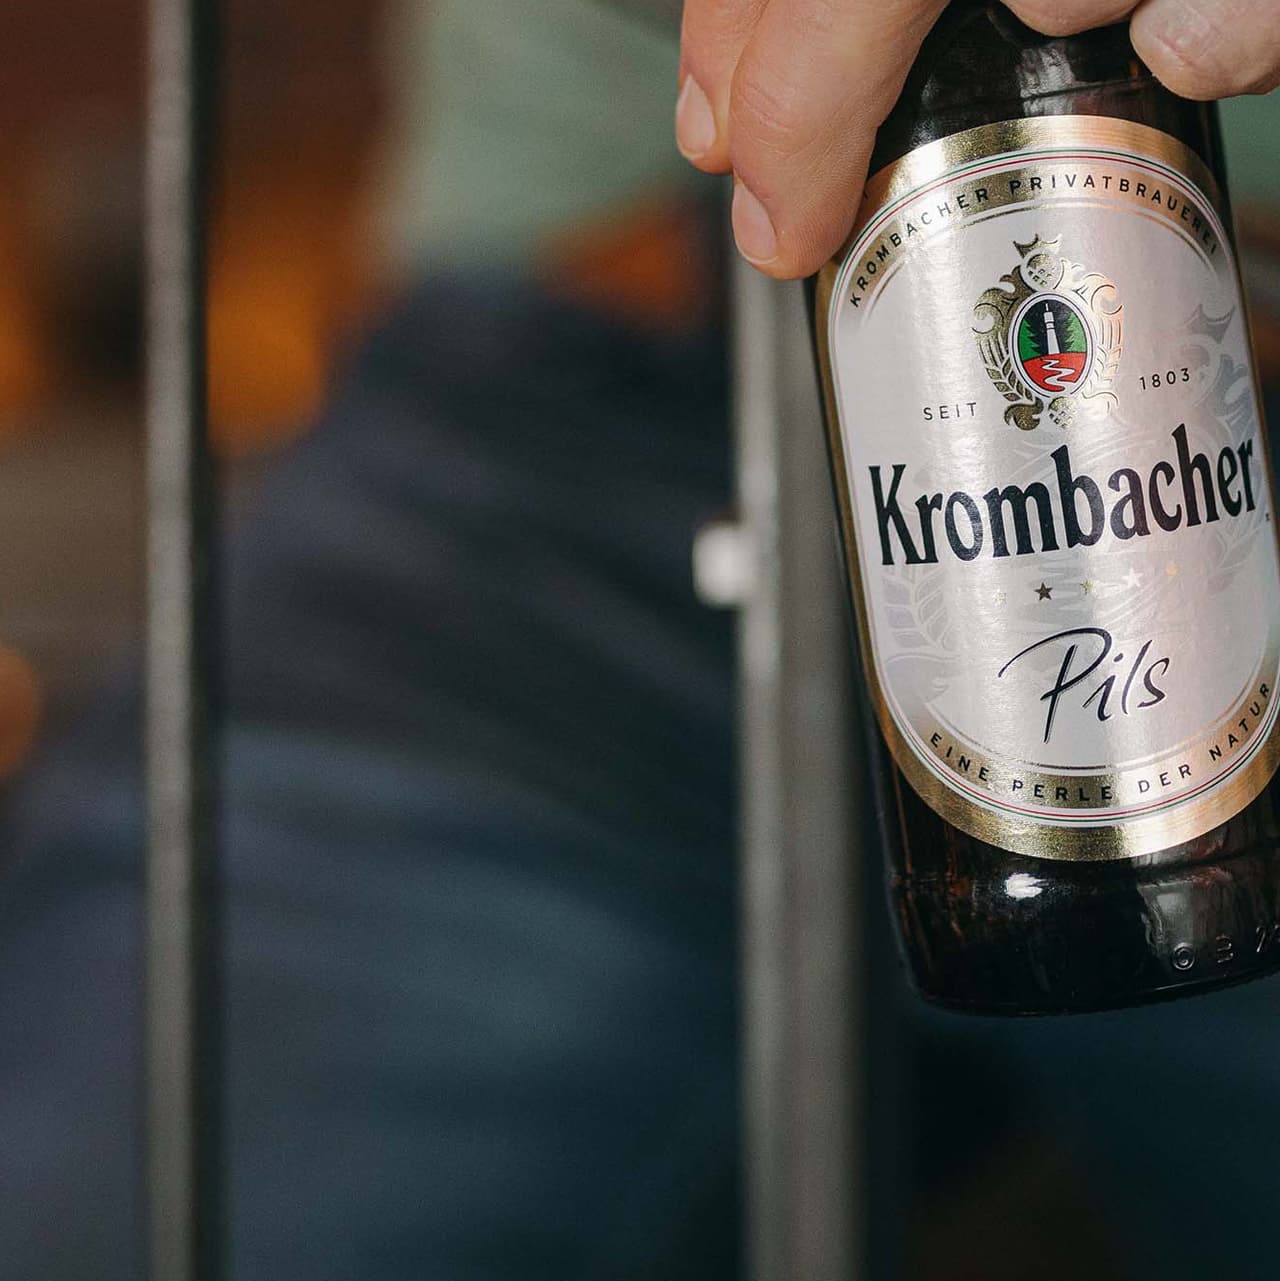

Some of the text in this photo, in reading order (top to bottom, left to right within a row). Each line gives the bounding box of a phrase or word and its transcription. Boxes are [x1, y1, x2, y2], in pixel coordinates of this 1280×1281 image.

[850, 174, 1218, 308] KROMBACHER PRIVATBRAUEREI
[922, 367, 1191, 421] SEIT 1803
[868, 423, 1257, 566] Krombacher
[929, 683, 1270, 802] EINE PERLE DER NATUR
[998, 626, 1171, 744] Pils
